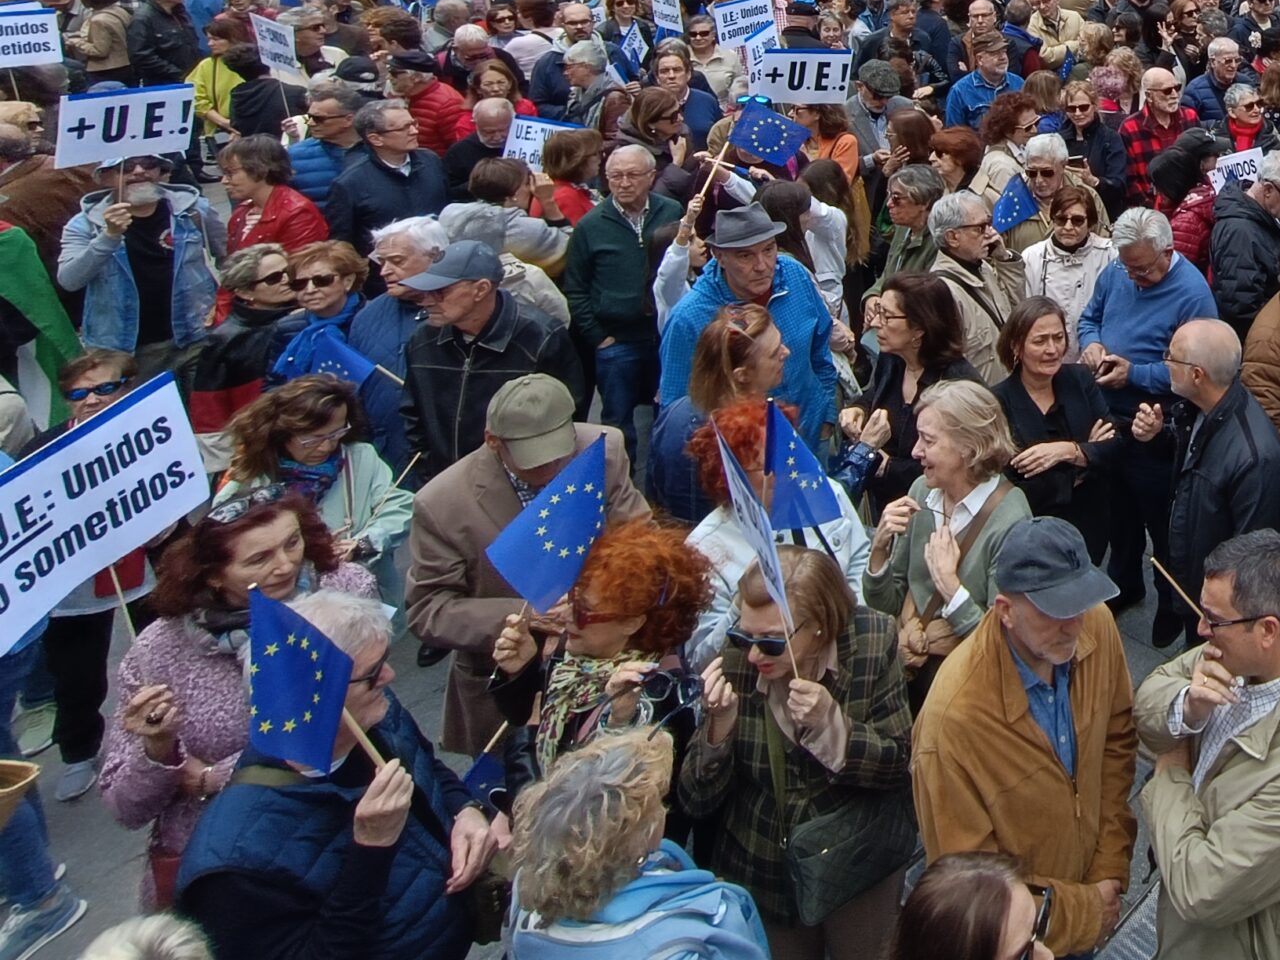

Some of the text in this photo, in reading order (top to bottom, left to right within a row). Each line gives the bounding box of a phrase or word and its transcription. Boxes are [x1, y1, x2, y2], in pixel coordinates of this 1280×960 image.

[740, 4, 769, 19] Unidos
[721, 32, 727, 42] o
[765, 61, 849, 92] +U.E.!
[67, 99, 193, 144] +U.E.!
[62, 416, 172, 500] Unidos
[14, 460, 196, 593] sometidos.
